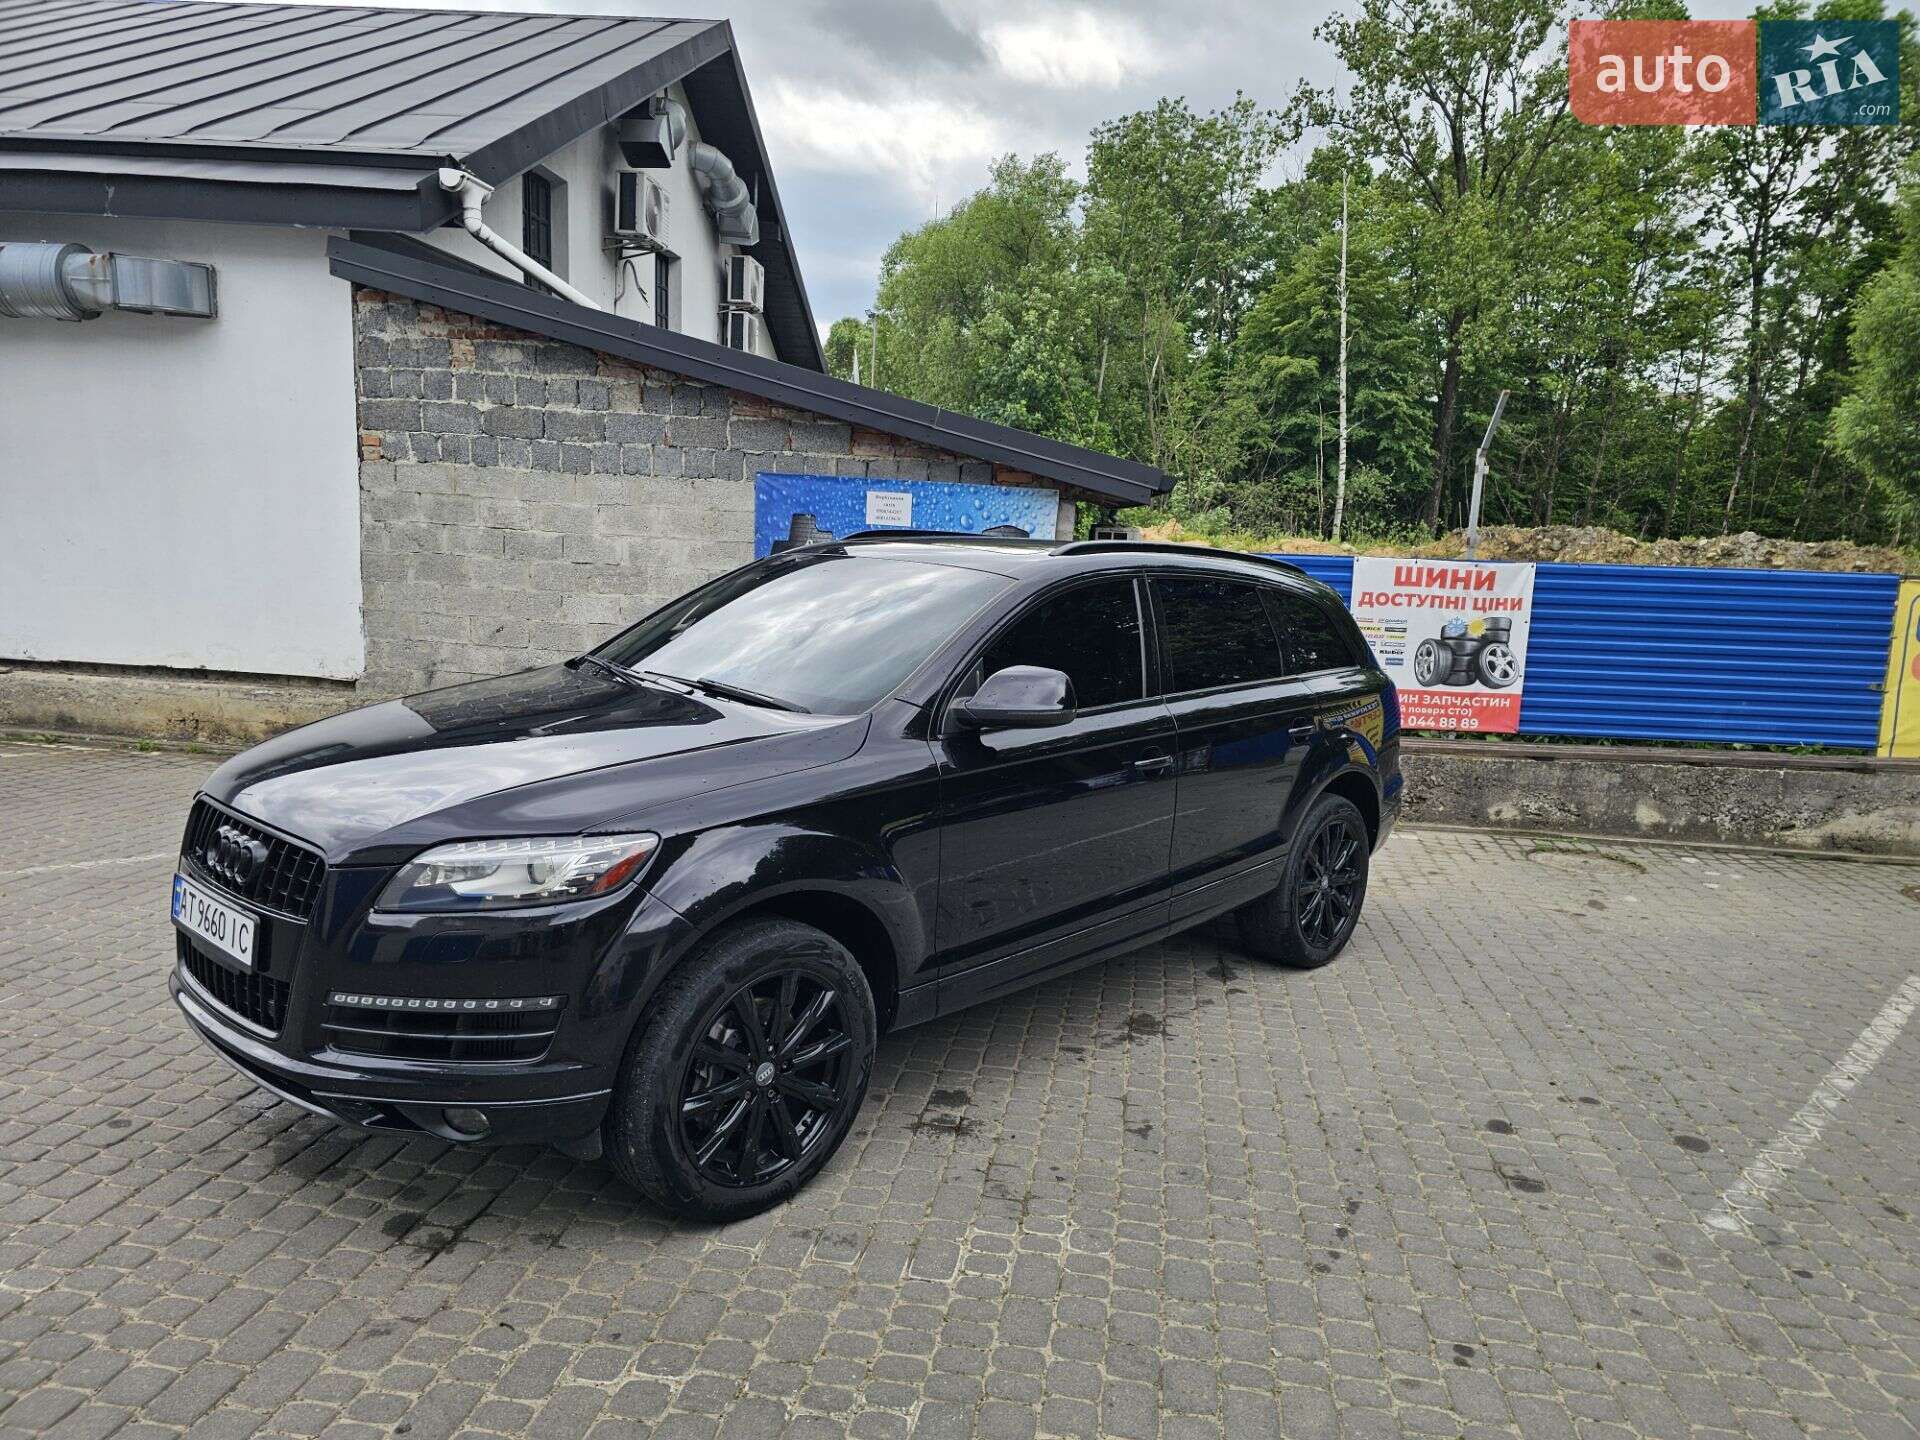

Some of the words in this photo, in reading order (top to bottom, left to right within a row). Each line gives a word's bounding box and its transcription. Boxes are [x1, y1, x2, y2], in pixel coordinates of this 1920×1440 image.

[1393, 565, 1497, 591] ШИНИ
[1358, 592, 1466, 610] ДОСТУПНІ
[1472, 597, 1523, 613] ЦІНИ
[1399, 693, 1419, 704] ИН
[1422, 694, 1511, 708] ЗАПЧАСТИН
[1408, 706, 1445, 715] поверх
[1407, 716, 1435, 727] 044
[1439, 717, 1457, 728] 88
[1461, 718, 1479, 729] 89
[180, 887, 197, 923] AT
[197, 899, 227, 941] 9660
[231, 918, 249, 954] IC
